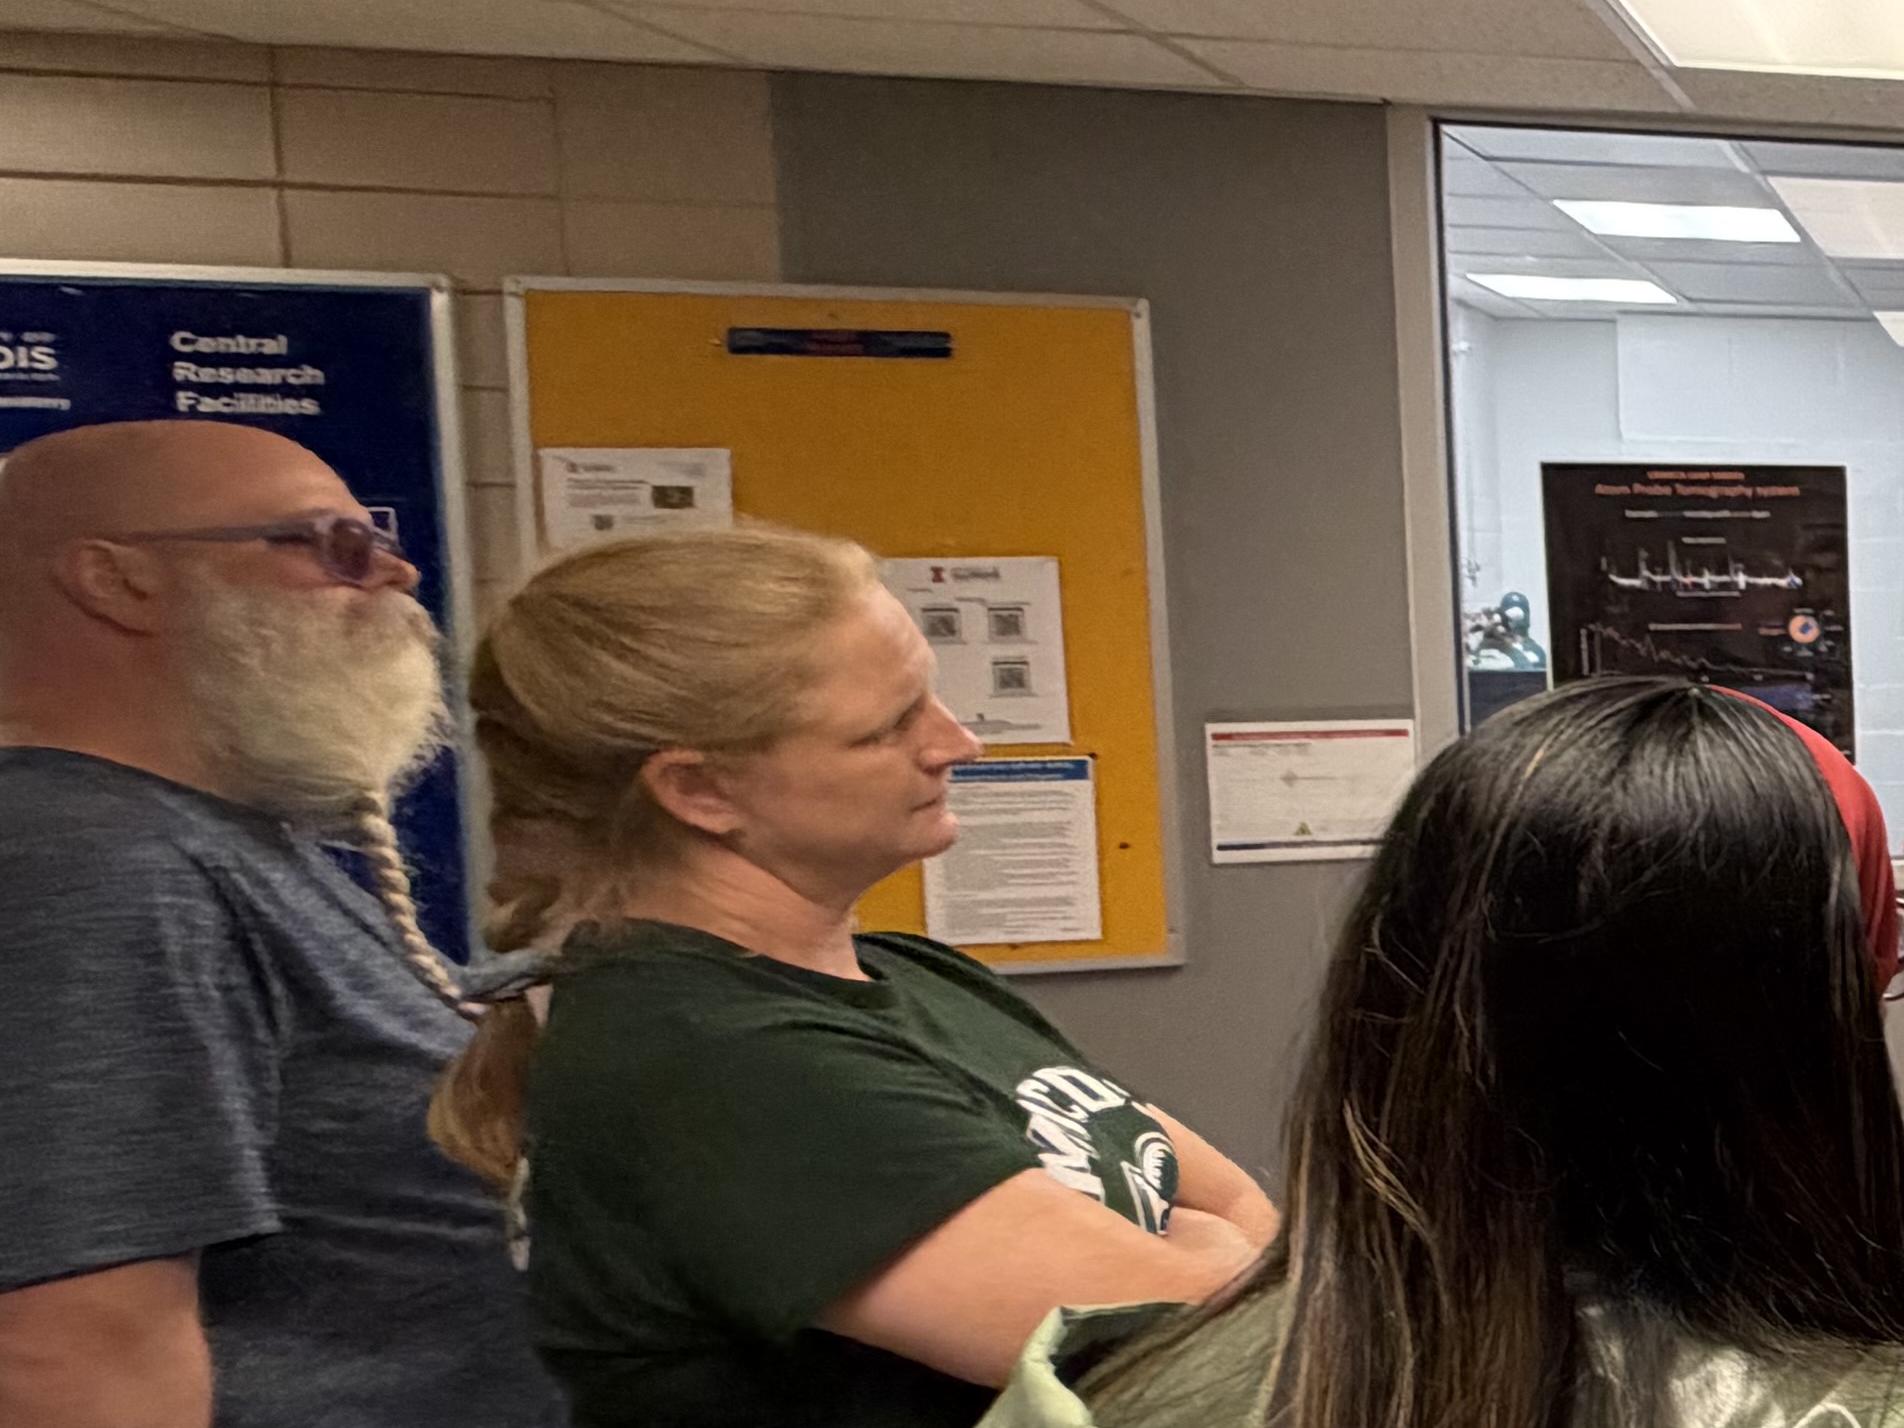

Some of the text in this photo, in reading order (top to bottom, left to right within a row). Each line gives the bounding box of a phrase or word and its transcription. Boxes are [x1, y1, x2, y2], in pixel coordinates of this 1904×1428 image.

[170, 331, 288, 354] Central
[173, 361, 325, 384] Research
[176, 391, 321, 414] Facilities
